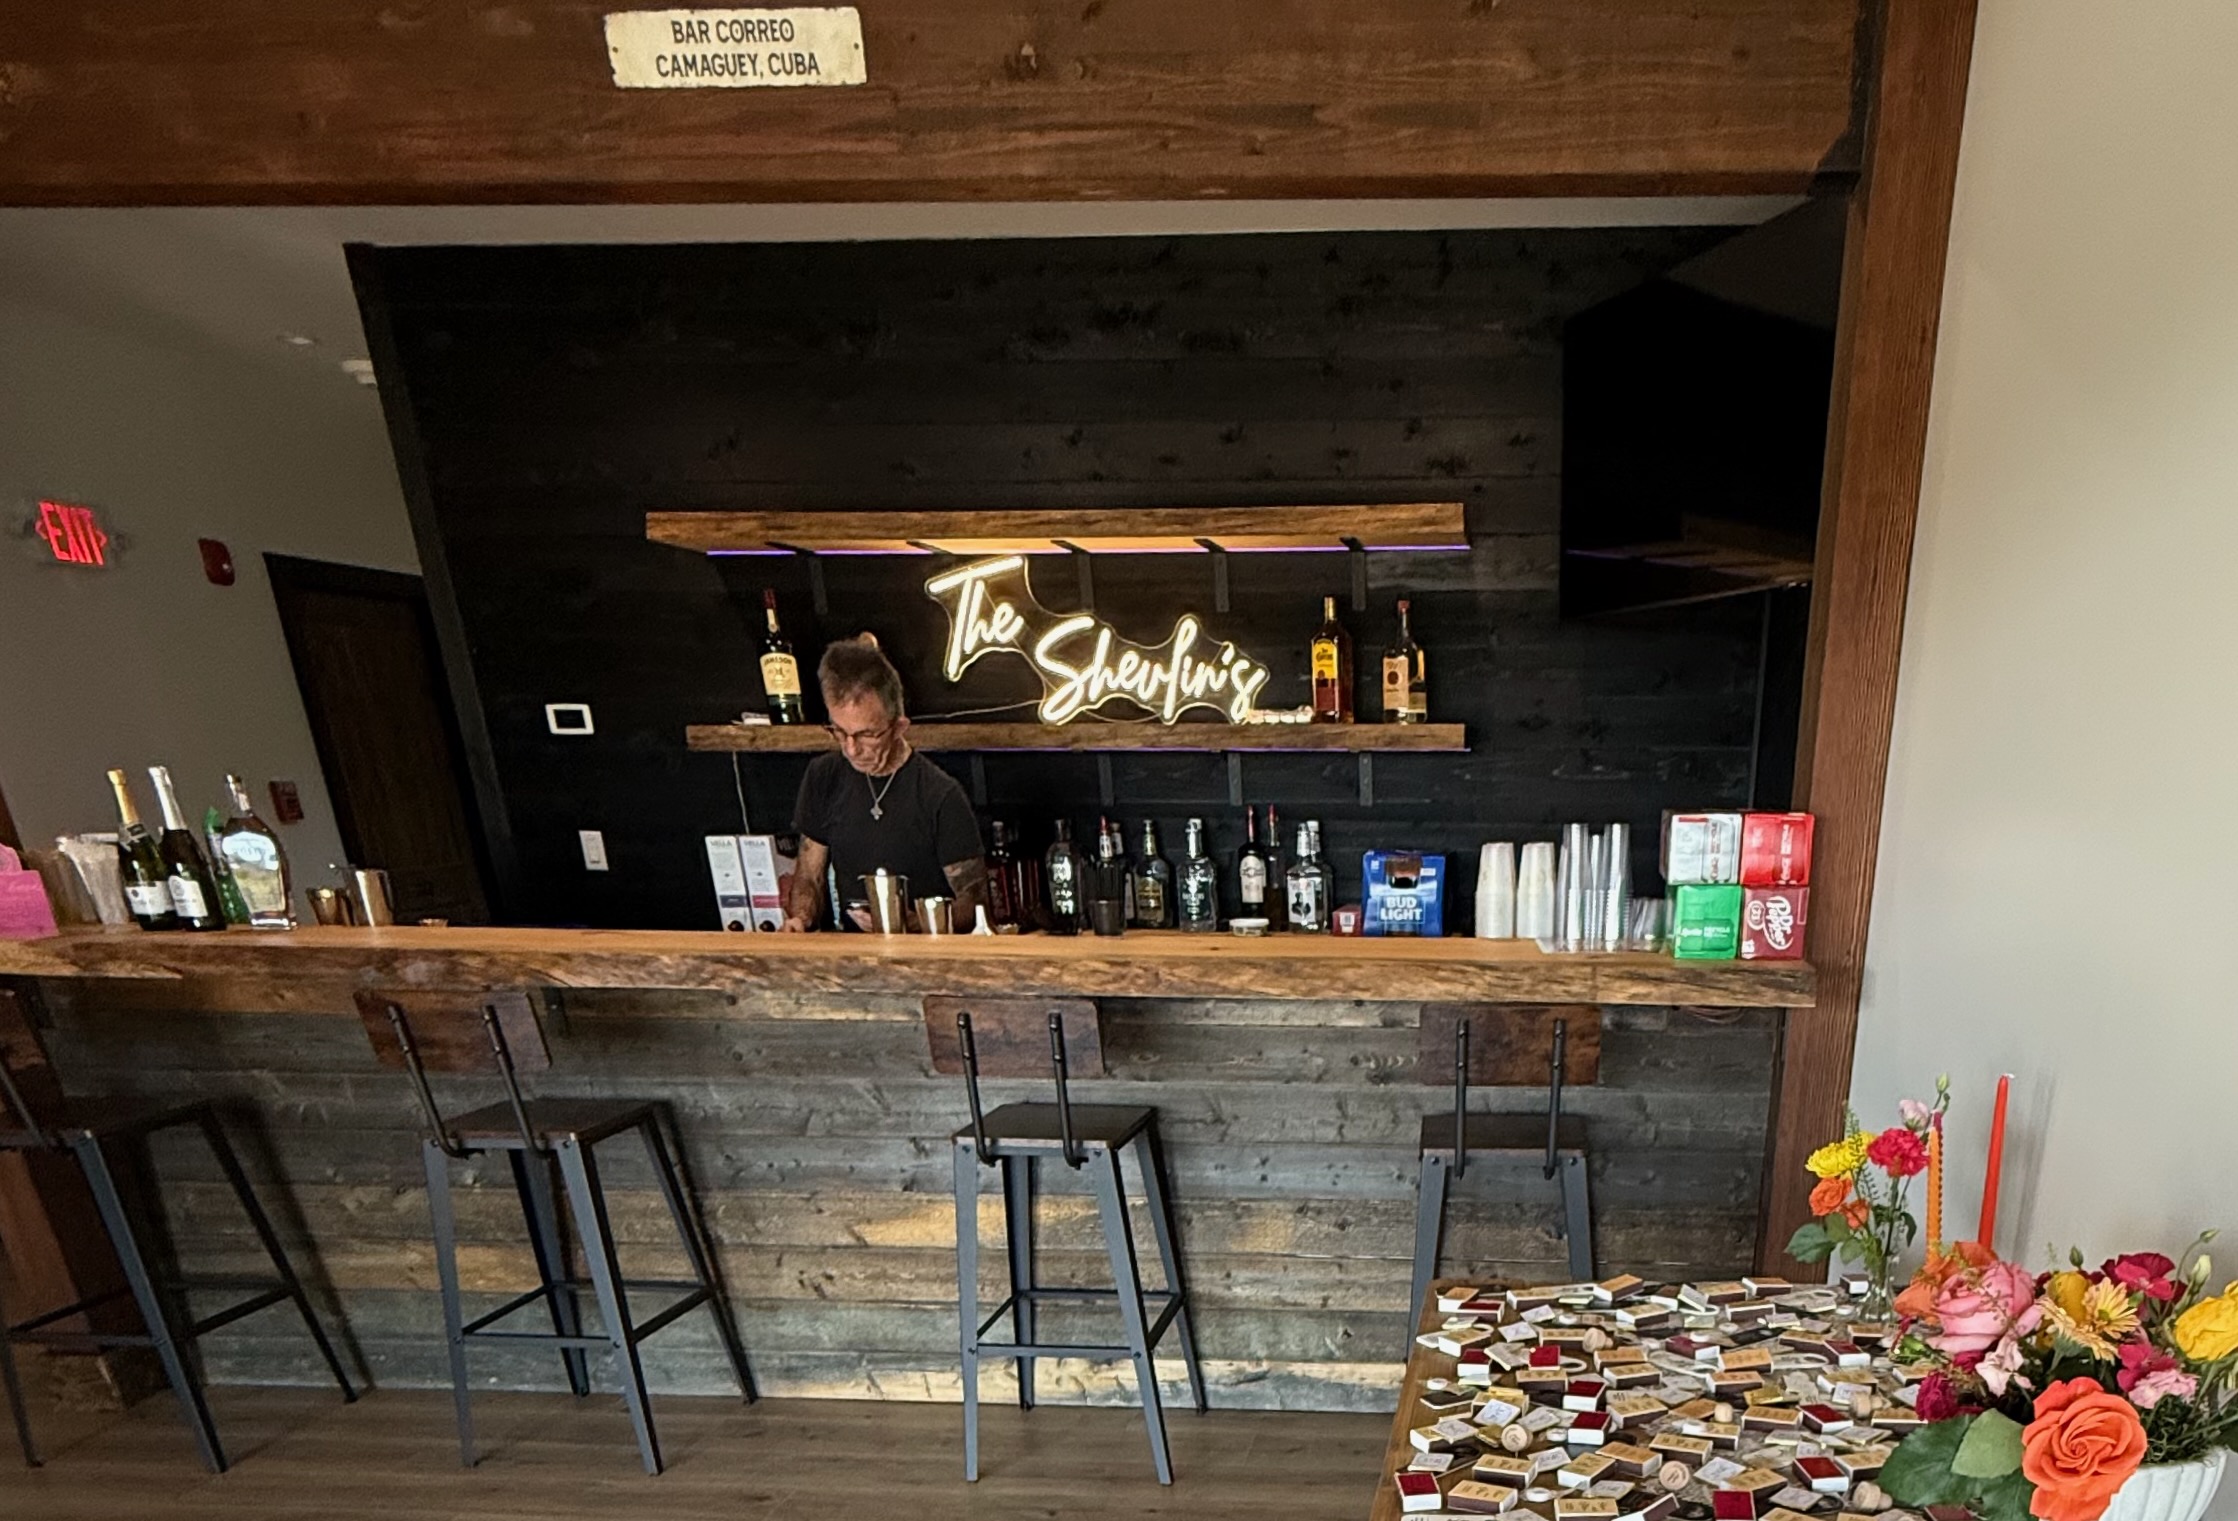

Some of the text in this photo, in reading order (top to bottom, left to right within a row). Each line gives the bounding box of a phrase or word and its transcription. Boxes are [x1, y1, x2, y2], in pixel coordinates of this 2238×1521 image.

[671, 18, 795, 44] BAR CORREO
[656, 52, 821, 79] CAMAGUEY, CUBA
[40, 502, 104, 566] EXIT
[928, 556, 1025, 679] The
[1035, 615, 1266, 723] Shevlin's
[1380, 908, 1422, 921] LIGHT
[1386, 896, 1417, 909] BUD
[1766, 896, 1793, 945] Dr Pepper
